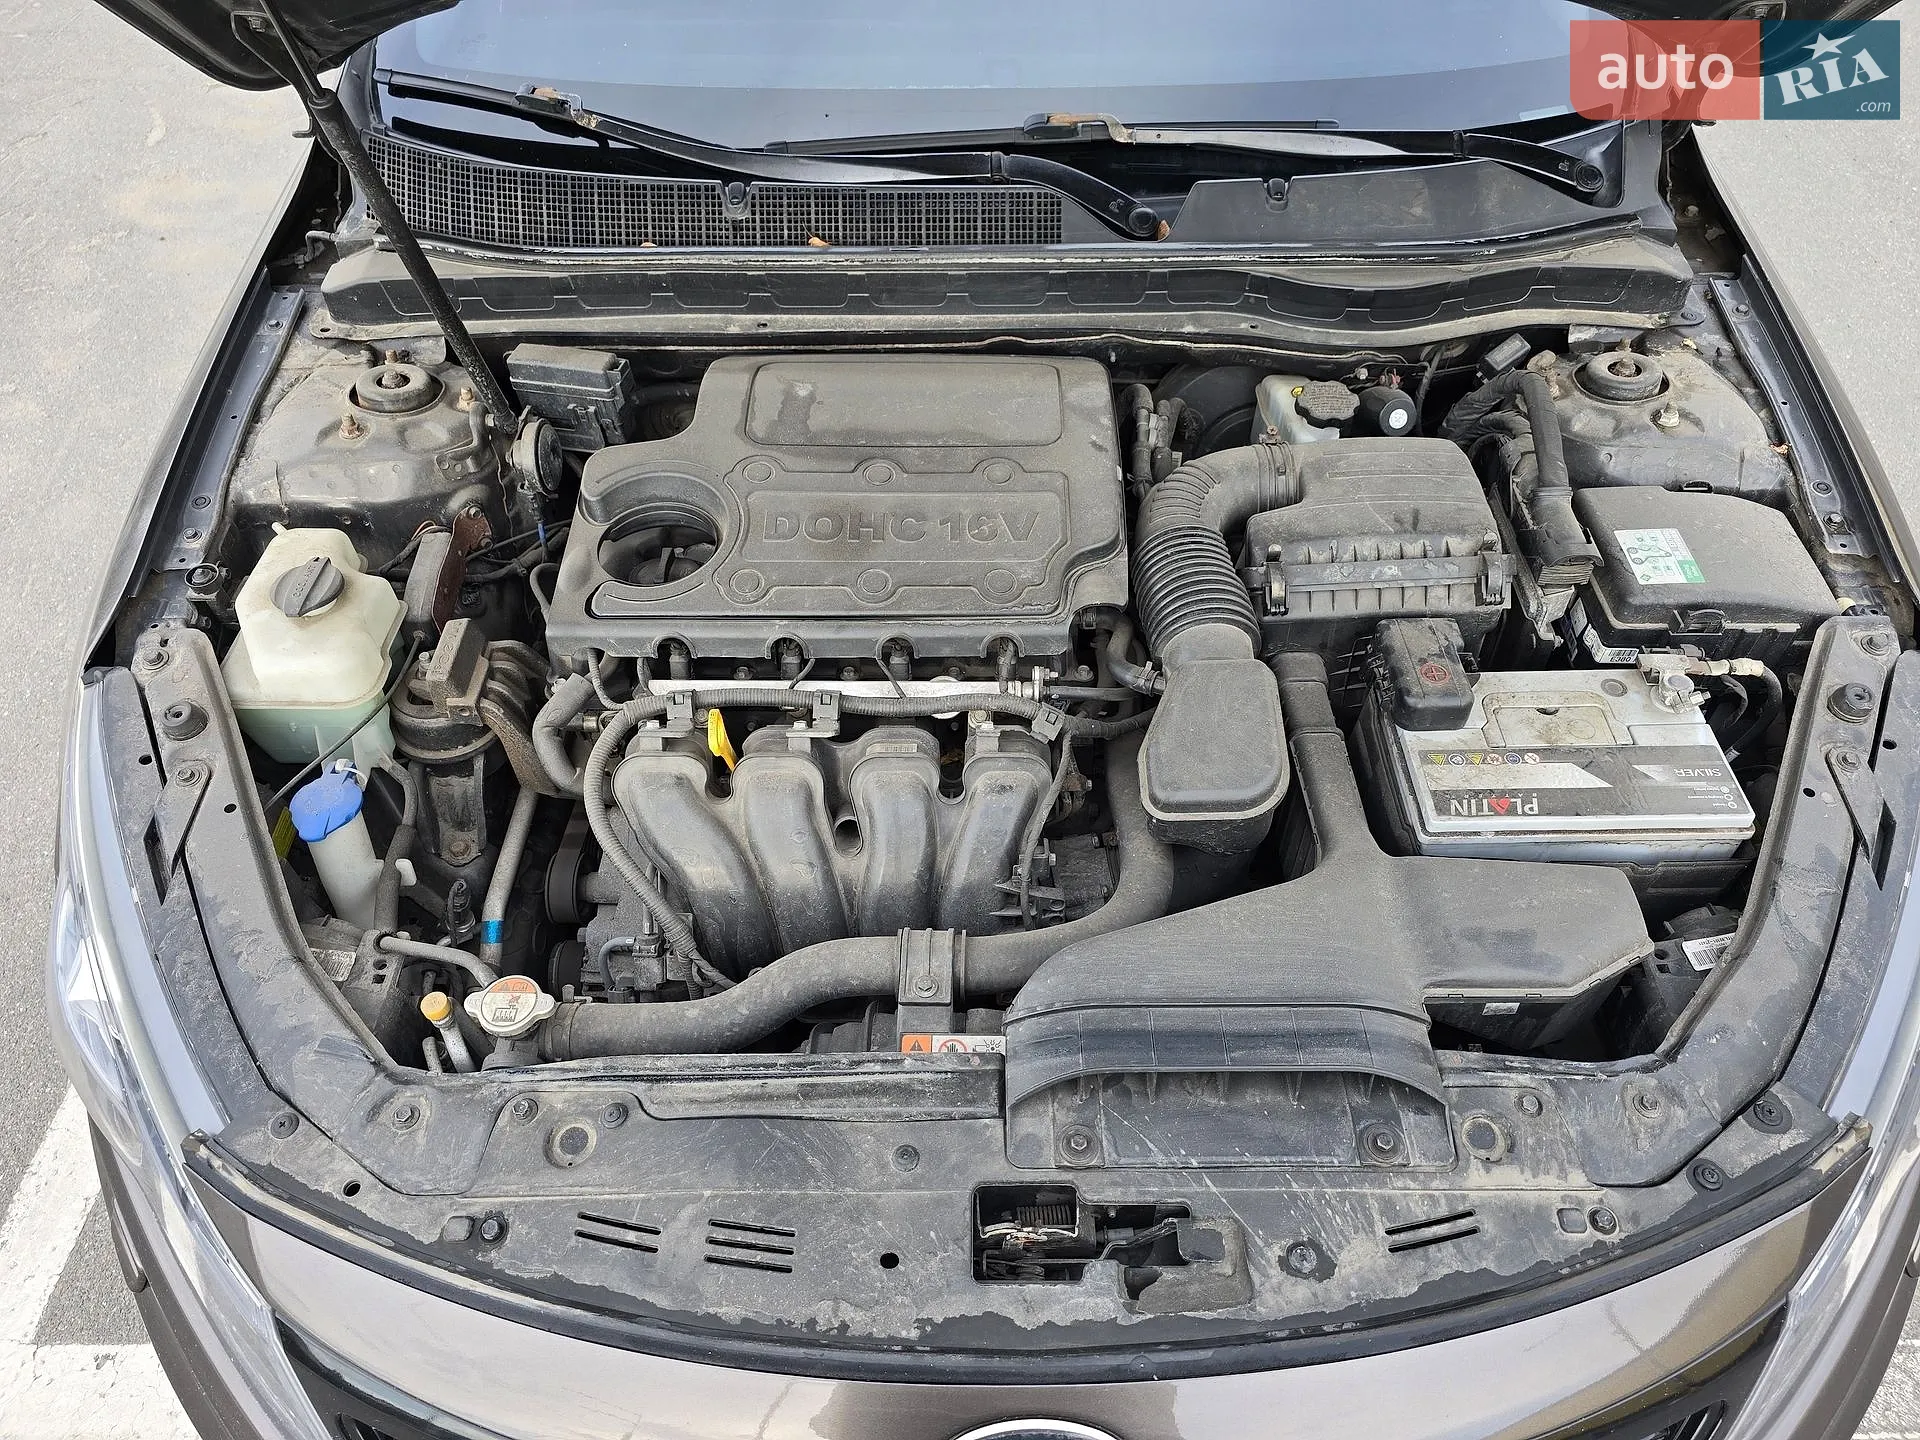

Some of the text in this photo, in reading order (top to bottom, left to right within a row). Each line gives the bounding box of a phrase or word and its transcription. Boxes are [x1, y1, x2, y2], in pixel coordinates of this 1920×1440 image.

[762, 511, 1039, 543] DOHC 16V
[1674, 768, 1721, 777] SILVER
[1450, 797, 1539, 816] PLATIN
